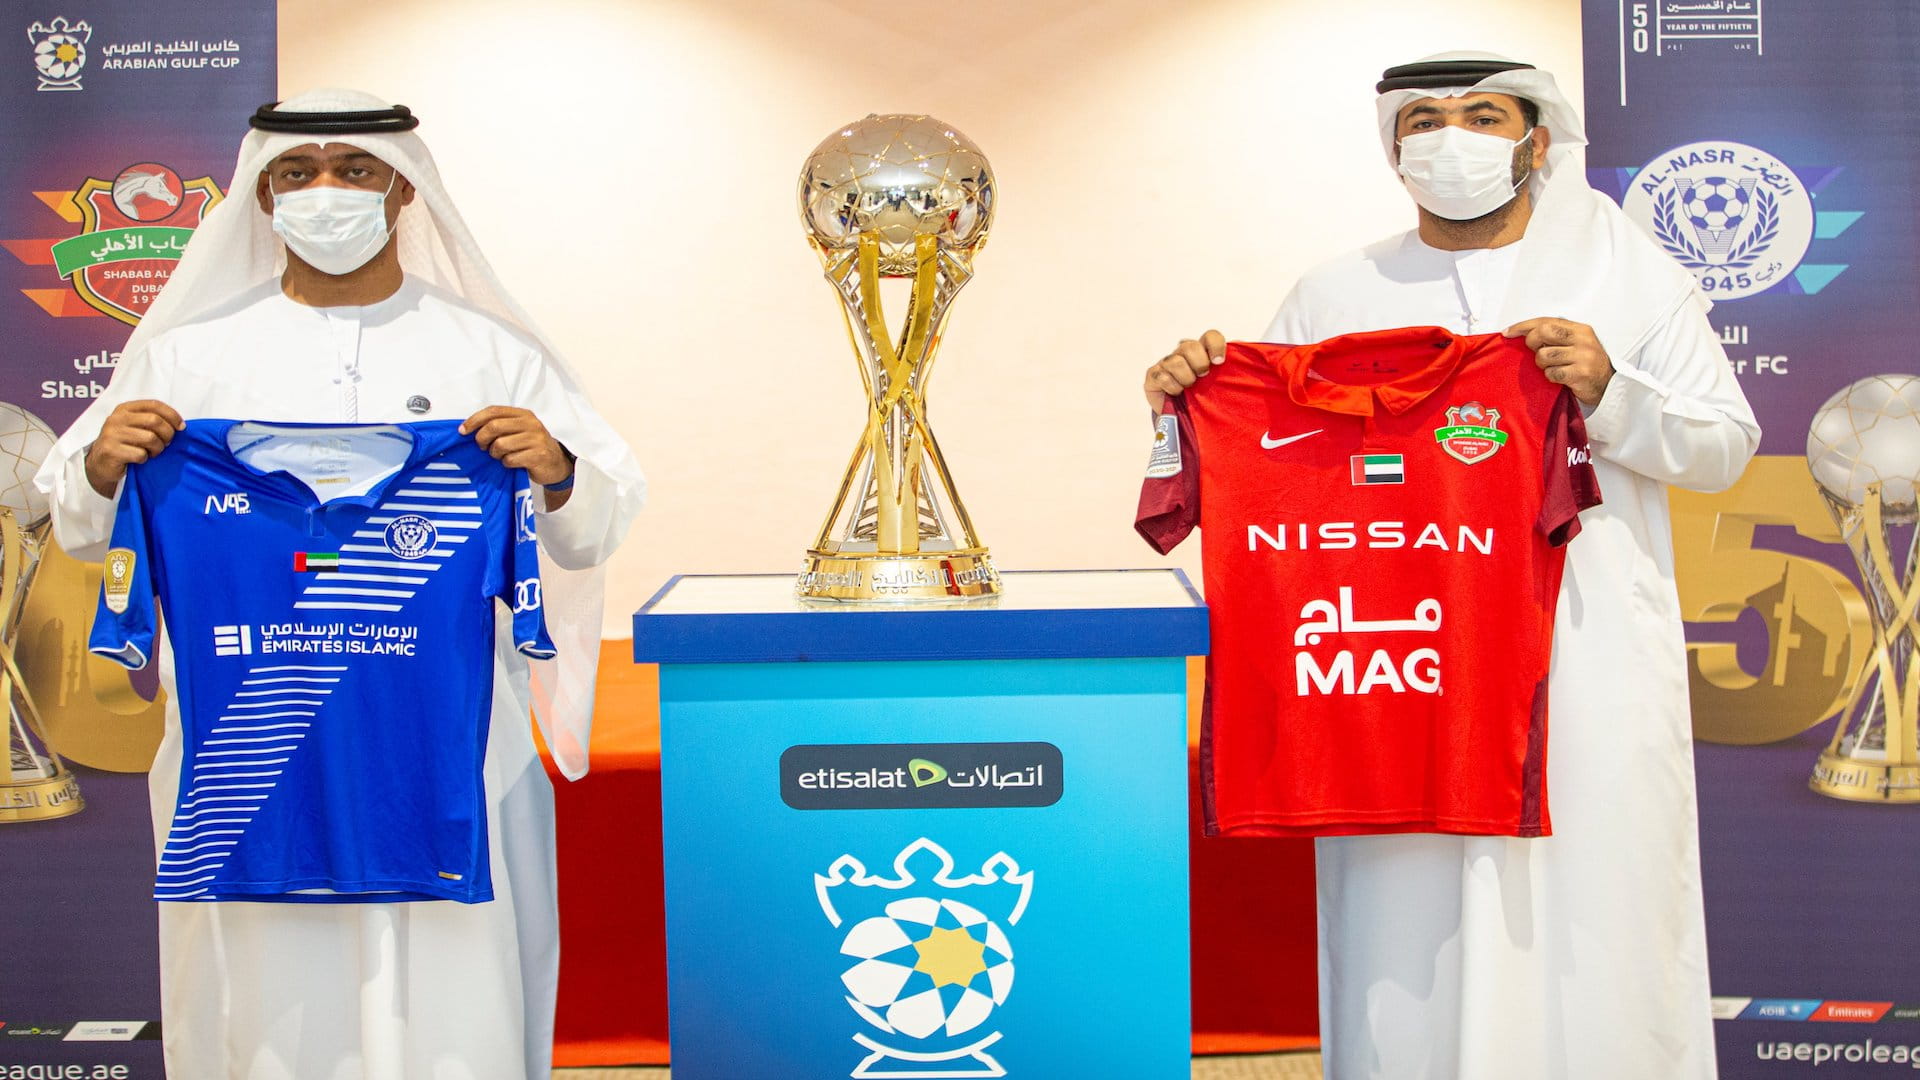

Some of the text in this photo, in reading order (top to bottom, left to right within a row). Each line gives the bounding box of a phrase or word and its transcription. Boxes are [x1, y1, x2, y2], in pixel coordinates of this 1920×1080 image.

[1665, 23, 1753, 31] YEAR OF THE FIFTIETH
[102, 41, 151, 56] العربي
[154, 40, 199, 54] الخليج
[102, 57, 240, 70] ARABIAN GULF CUP
[1641, 149, 1735, 196] AL-NASR
[149, 235, 188, 255] باب
[103, 270, 151, 279] SHABAB
[1701, 272, 1752, 292] 945
[131, 284, 164, 294] DUBA
[1755, 355, 1789, 375] FC
[40, 380, 106, 399] Shab
[1247, 521, 1494, 555] NISSAN
[1294, 586, 1442, 646] ماج
[260, 622, 418, 642] الإمارات الإسلامي
[261, 639, 417, 657] EMIRATES ISLAMIC
[1295, 647, 1442, 697] MAG
[798, 764, 1043, 790] etisalat اتصالات
